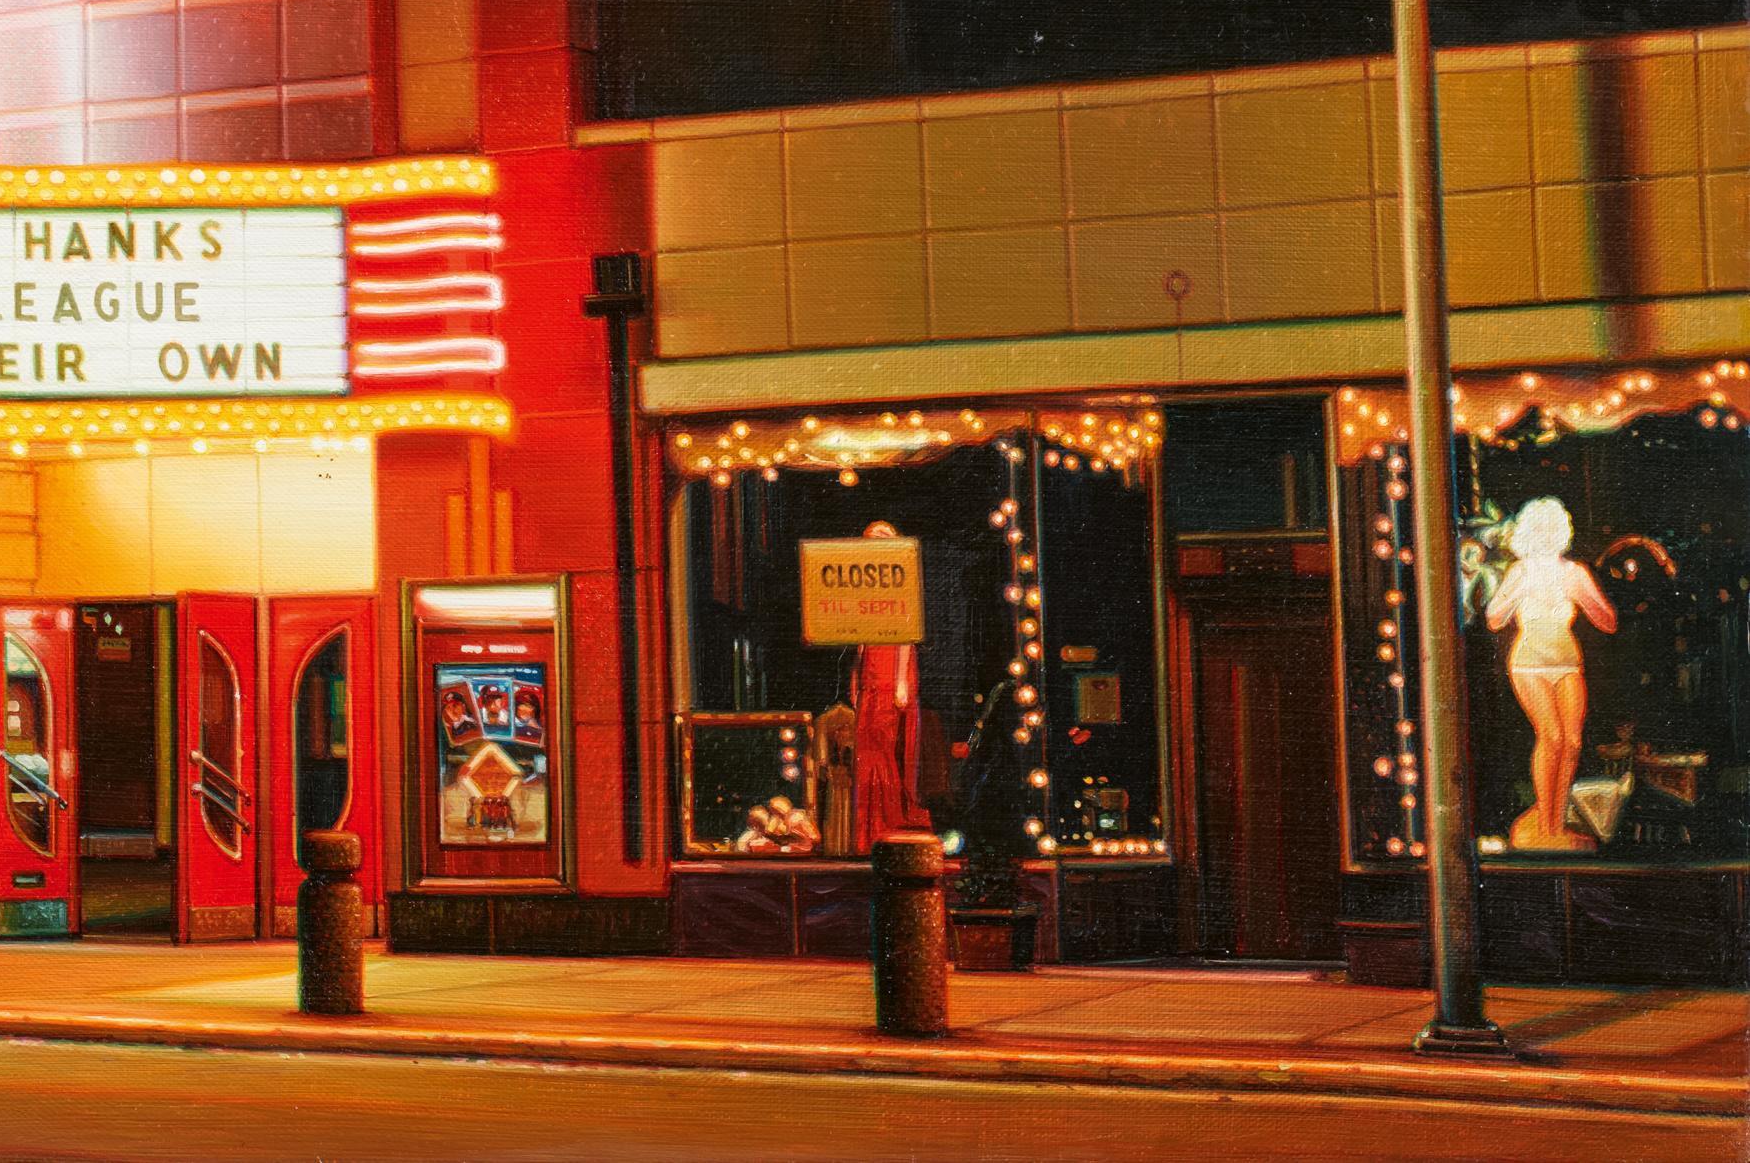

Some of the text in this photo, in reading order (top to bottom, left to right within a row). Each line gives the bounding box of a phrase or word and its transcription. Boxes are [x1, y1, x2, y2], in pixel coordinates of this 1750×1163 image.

[23, 219, 224, 263] HANKS
[158, 342, 283, 383] OWN
[820, 563, 906, 589] CLOSED
